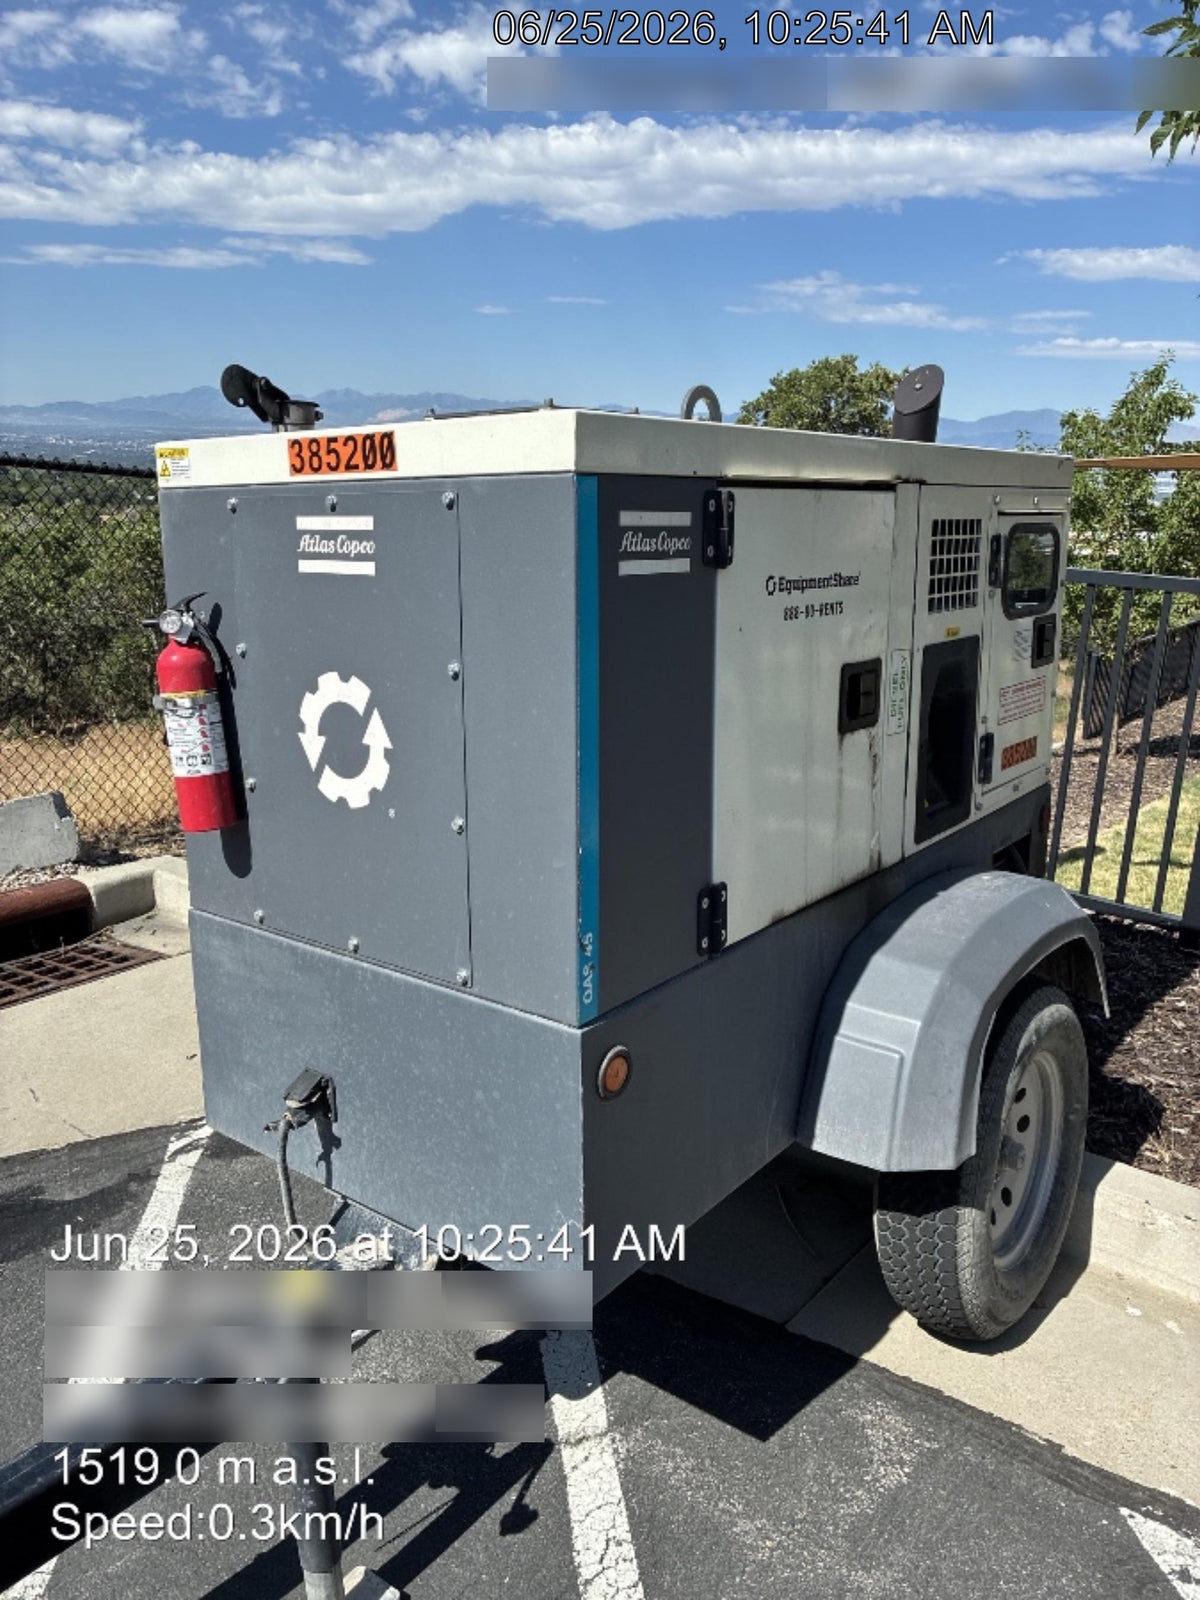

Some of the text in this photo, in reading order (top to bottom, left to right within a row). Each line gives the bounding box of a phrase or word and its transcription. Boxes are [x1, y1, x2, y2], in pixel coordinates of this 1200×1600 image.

[290, 431, 396, 474] 385200
[297, 534, 376, 557] Atlas Copco
[619, 531, 691, 555] Atlas Copco
